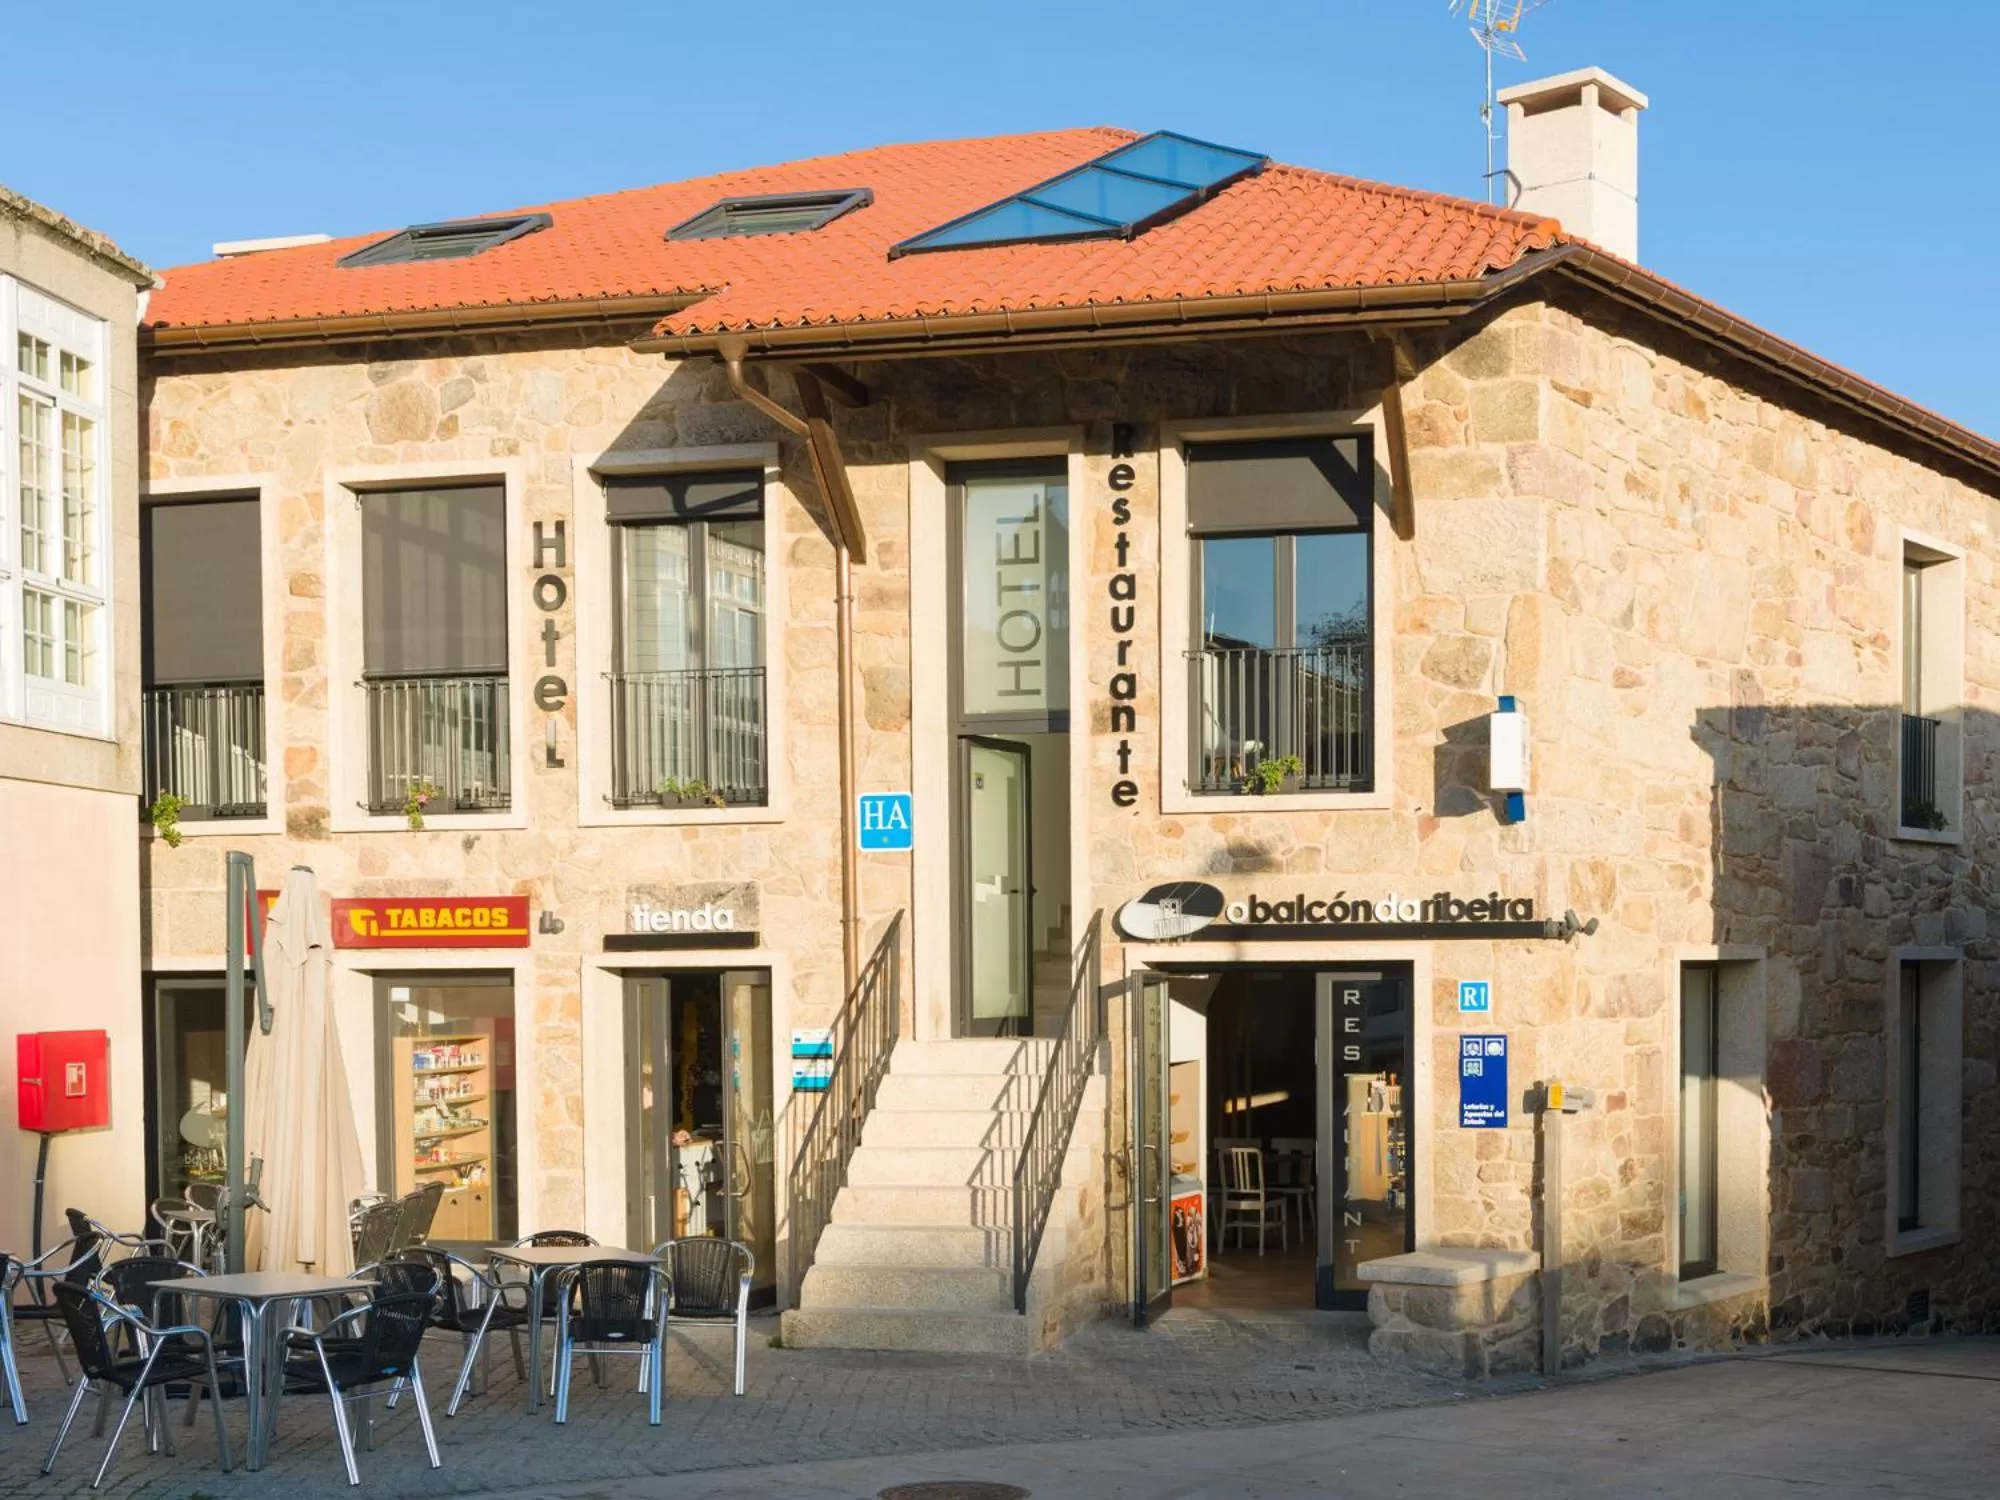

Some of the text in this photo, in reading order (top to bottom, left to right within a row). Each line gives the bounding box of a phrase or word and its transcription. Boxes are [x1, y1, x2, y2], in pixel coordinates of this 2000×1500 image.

[996, 493, 1041, 697] HOTEL
[1107, 423, 1139, 808] Restaurante
[862, 800, 909, 830] HA
[386, 907, 509, 929] TABACOS
[631, 901, 734, 932] tienda
